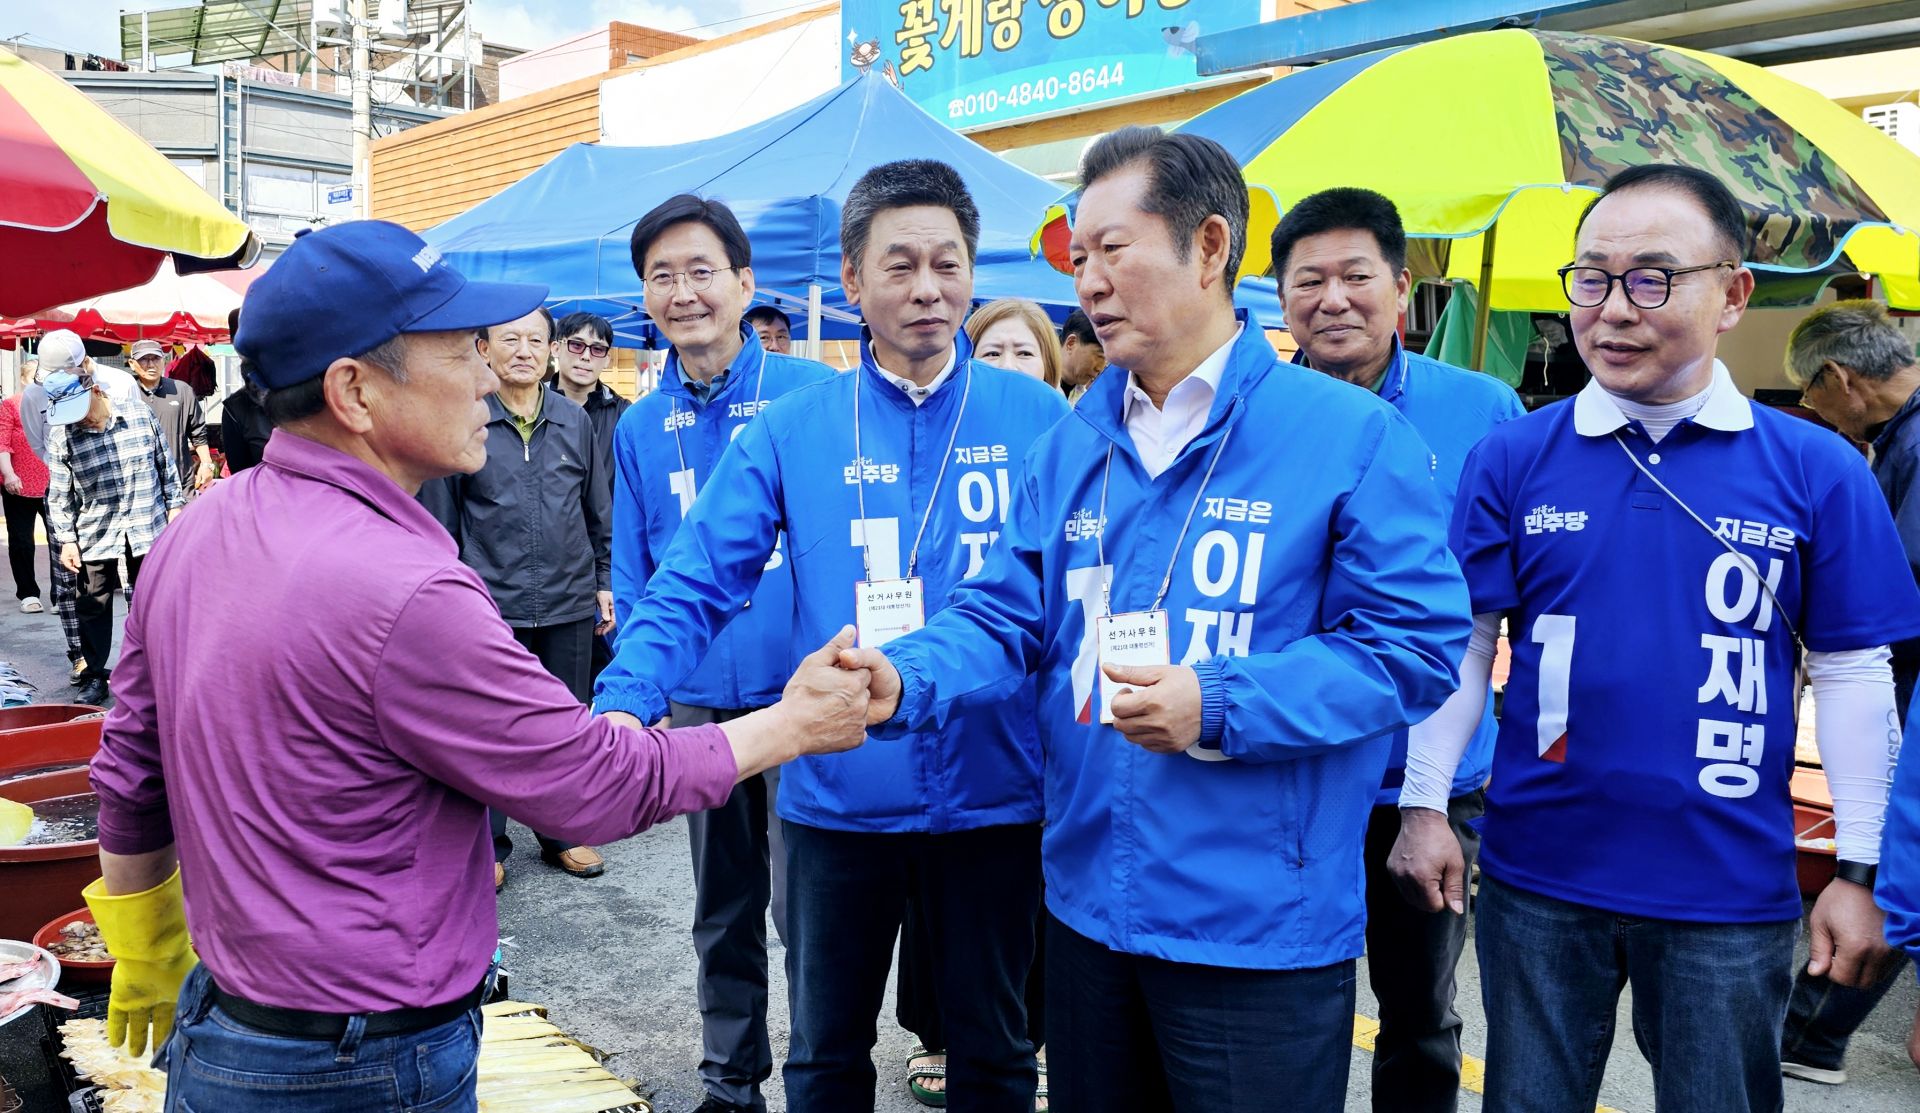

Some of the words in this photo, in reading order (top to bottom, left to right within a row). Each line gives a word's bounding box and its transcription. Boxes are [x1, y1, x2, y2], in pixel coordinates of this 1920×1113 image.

[964, 62, 1124, 113] 010-4840-8644
[955, 445, 1009, 465] 지금은
[843, 464, 900, 485] 민주당
[1202, 498, 1273, 524] 지금은
[1524, 511, 1589, 535] 민주당
[1713, 516, 1796, 552] 지금은
[867, 591, 912, 602] 선거사무원
[1109, 626, 1157, 640] 선거사무원
[1696, 551, 1784, 799] 이재명
[1531, 614, 1576, 763] 1
